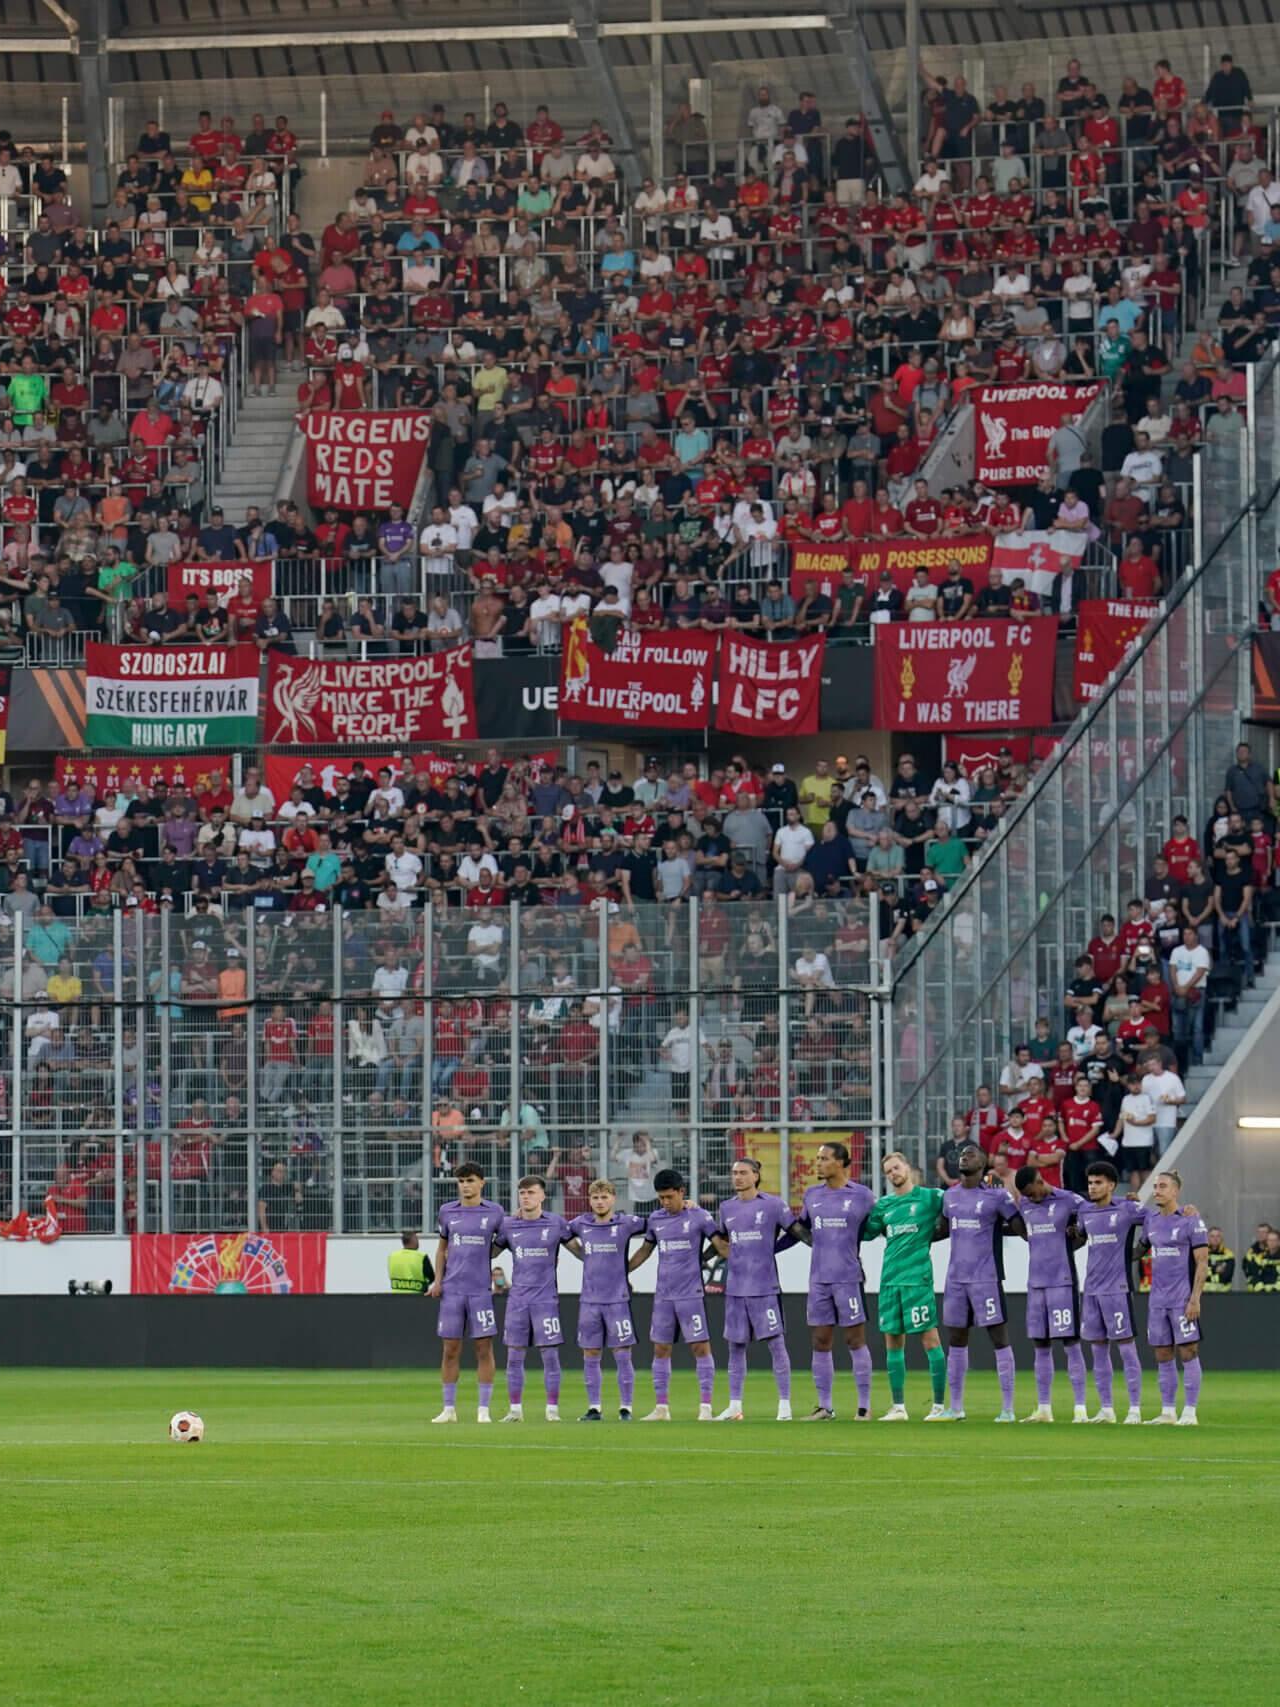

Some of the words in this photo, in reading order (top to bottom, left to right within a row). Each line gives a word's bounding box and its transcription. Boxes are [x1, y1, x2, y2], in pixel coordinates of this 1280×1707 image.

[306, 413, 431, 444] URGENS
[315, 444, 395, 477] REDS
[979, 467, 1014, 481] PURE
[315, 474, 394, 507] MATE
[859, 553, 881, 571] NO
[886, 545, 989, 570] POSSESSIONS
[181, 568, 211, 586] IT'S
[212, 567, 254, 587] BOSS
[1107, 602, 1132, 618] THE
[1133, 604, 1160, 619] FAC
[898, 625, 995, 649] LIVERPOOL
[1007, 624, 1032, 647] FC
[119, 651, 226, 676] SZOBOSZLAI
[320, 657, 443, 688] LIVERPOOL
[444, 649, 470, 673] FC
[643, 647, 709, 667] FOLLOW
[728, 643, 818, 680] HILLY
[95, 685, 249, 715] SZÉKESFEHÉRVÁR
[321, 690, 388, 714] MAKE
[389, 686, 435, 710] THE
[522, 687, 560, 710] UE
[586, 685, 689, 715] LIVERPOOL
[730, 683, 801, 721] LFC
[332, 710, 421, 736] PEOPLE
[898, 702, 905, 723] I
[916, 701, 953, 723] WAS
[963, 700, 1021, 722] THERE
[131, 723, 208, 747] HUNGARY
[391, 1279, 423, 1291] EWARD
[766, 1309, 777, 1325] 9
[849, 1296, 858, 1315] 4
[910, 1306, 930, 1325] 62
[985, 1298, 996, 1316] 5
[476, 1309, 495, 1327] 43
[543, 1317, 561, 1335] 50
[615, 1320, 633, 1338] 19
[691, 1314, 702, 1332] 3
[1052, 1309, 1072, 1327] 38
[1114, 1312, 1124, 1330] 7
